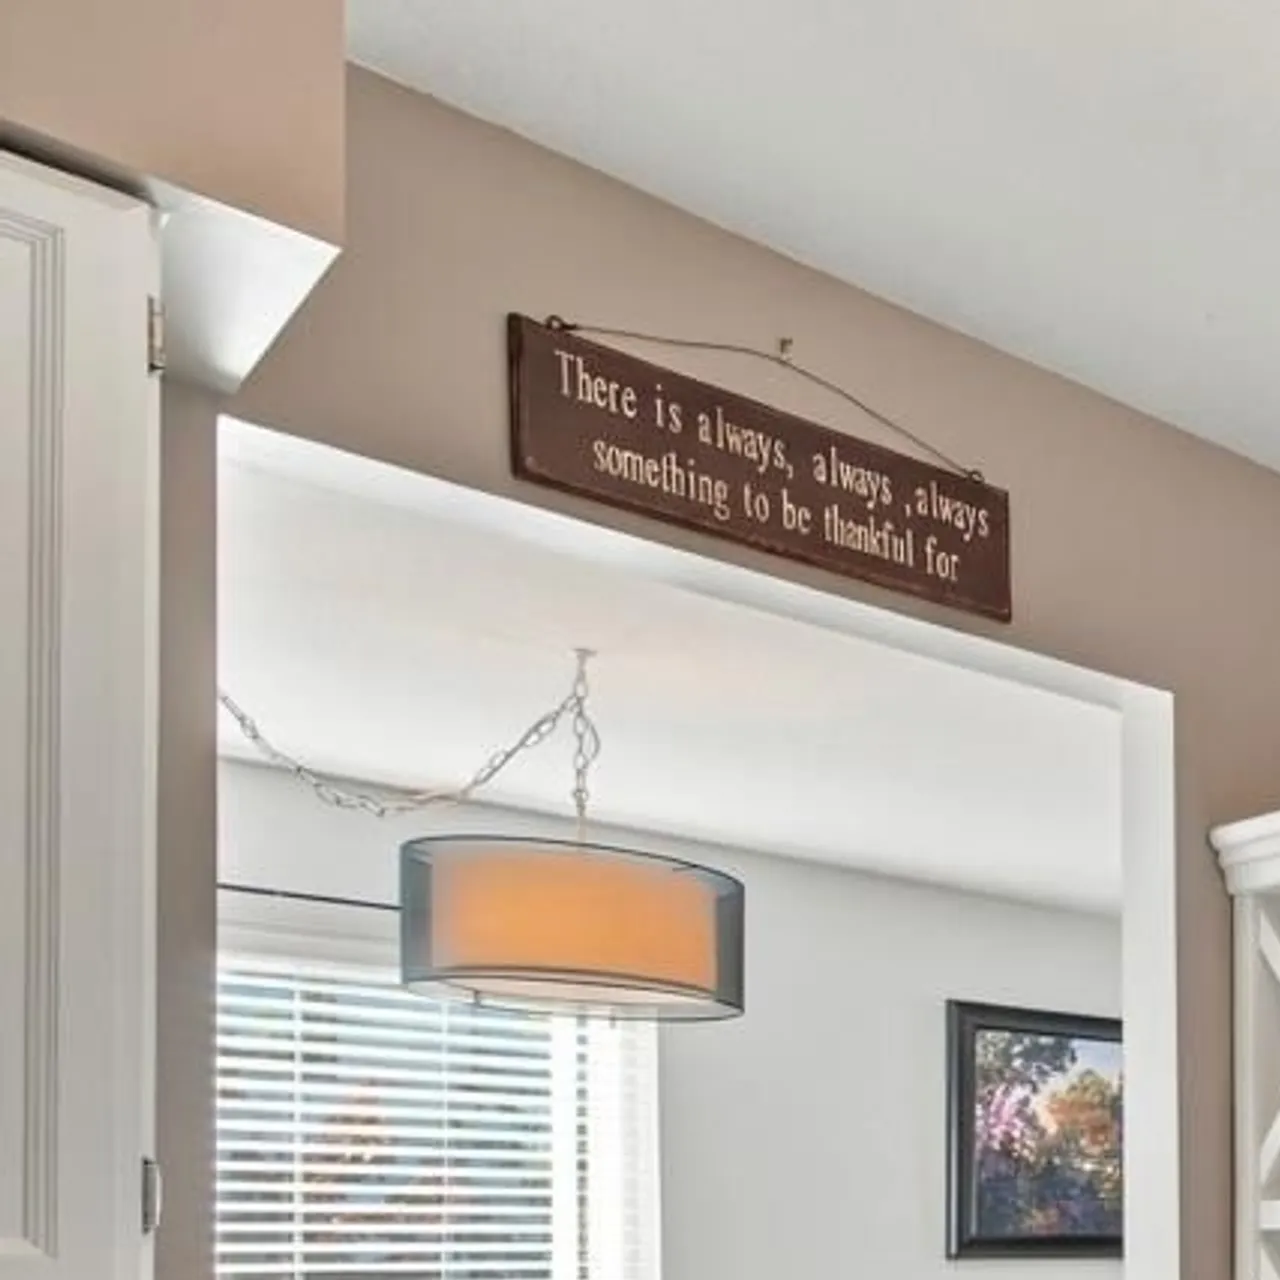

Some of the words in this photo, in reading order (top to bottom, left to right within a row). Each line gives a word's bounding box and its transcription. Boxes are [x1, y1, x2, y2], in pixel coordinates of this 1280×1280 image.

[554, 350, 637, 418] There
[655, 383, 682, 434] is
[697, 406, 794, 479] always,
[812, 447, 893, 509] always
[593, 438, 730, 521] something
[743, 483, 770, 523] to
[782, 488, 811, 534] be
[824, 504, 915, 568] thankful
[924, 535, 959, 582] for
